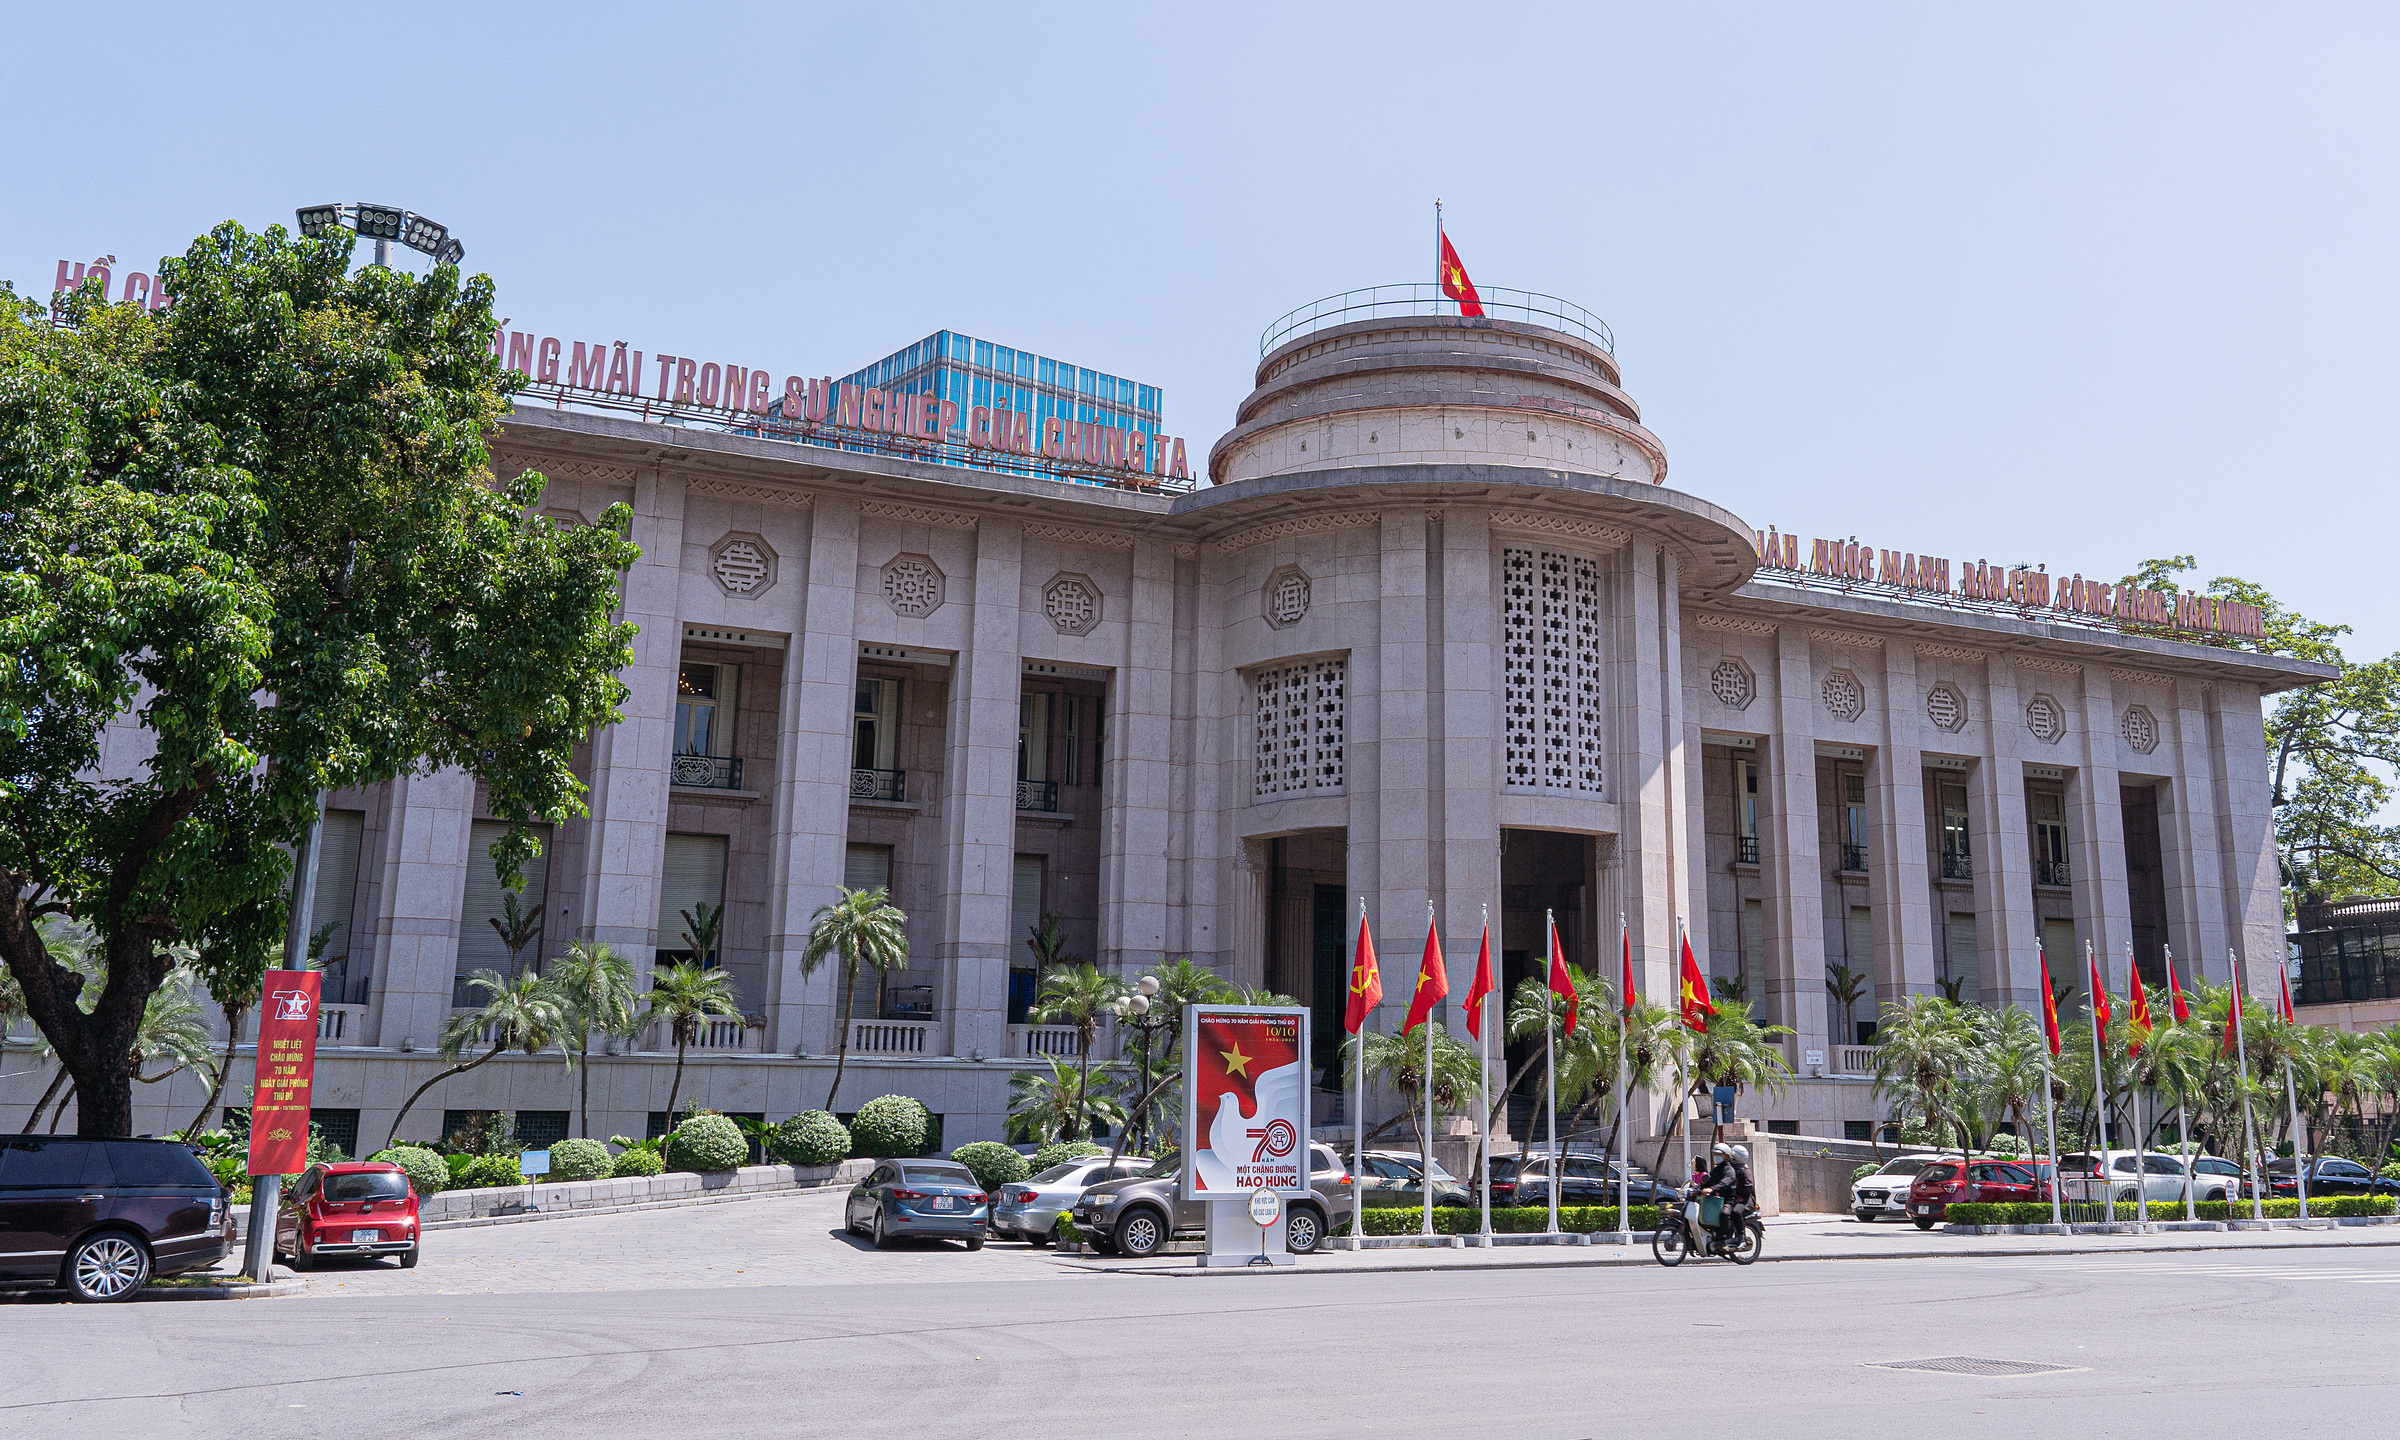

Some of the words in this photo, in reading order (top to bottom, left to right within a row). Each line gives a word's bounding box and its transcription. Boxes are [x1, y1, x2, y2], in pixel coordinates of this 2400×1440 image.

[53, 254, 116, 308] HỒ
[484, 317, 561, 384] ỐNG
[569, 340, 643, 396] MÃI
[656, 353, 770, 414] TRONG
[783, 375, 831, 429] SỰ
[836, 382, 957, 447] NGHIỆP
[969, 396, 1030, 455] CỦA
[1041, 416, 1146, 471] CHÚNG
[1153, 433, 1189, 479] TA
[1813, 535, 1874, 580] NƯỚC
[1962, 558, 2005, 601] DÂN
[2058, 572, 2113, 617] CÔNG
[2175, 589, 2214, 631] VĂN
[1237, 1017, 1248, 1025] NĂM
[1260, 1017, 1276, 1025] PHÓNG
[1265, 1026, 1295, 1037] 10/10
[273, 1038, 290, 1051] NHIỆT
[290, 1038, 302, 1051] LIỆT
[269, 1052, 285, 1062] CHÀO
[286, 1052, 303, 1062] MỪNG
[274, 1066, 282, 1075] 70
[282, 1065, 296, 1075] NĂM
[260, 1076, 276, 1088] NGÀY
[276, 1076, 288, 1088] GIẢI
[289, 1076, 309, 1088] PHÓNG
[273, 1089, 285, 1101] THỦ
[285, 1090, 294, 1101] ĐÔ
[1245, 1118, 1297, 1163] 70
[1236, 1164, 1251, 1176] MỘT
[1252, 1164, 1274, 1176] CHẶNG
[1275, 1163, 1297, 1174] ĐƯỜNG
[1236, 1174, 1263, 1188] HÀO
[1265, 1174, 1297, 1188] HÙNG
